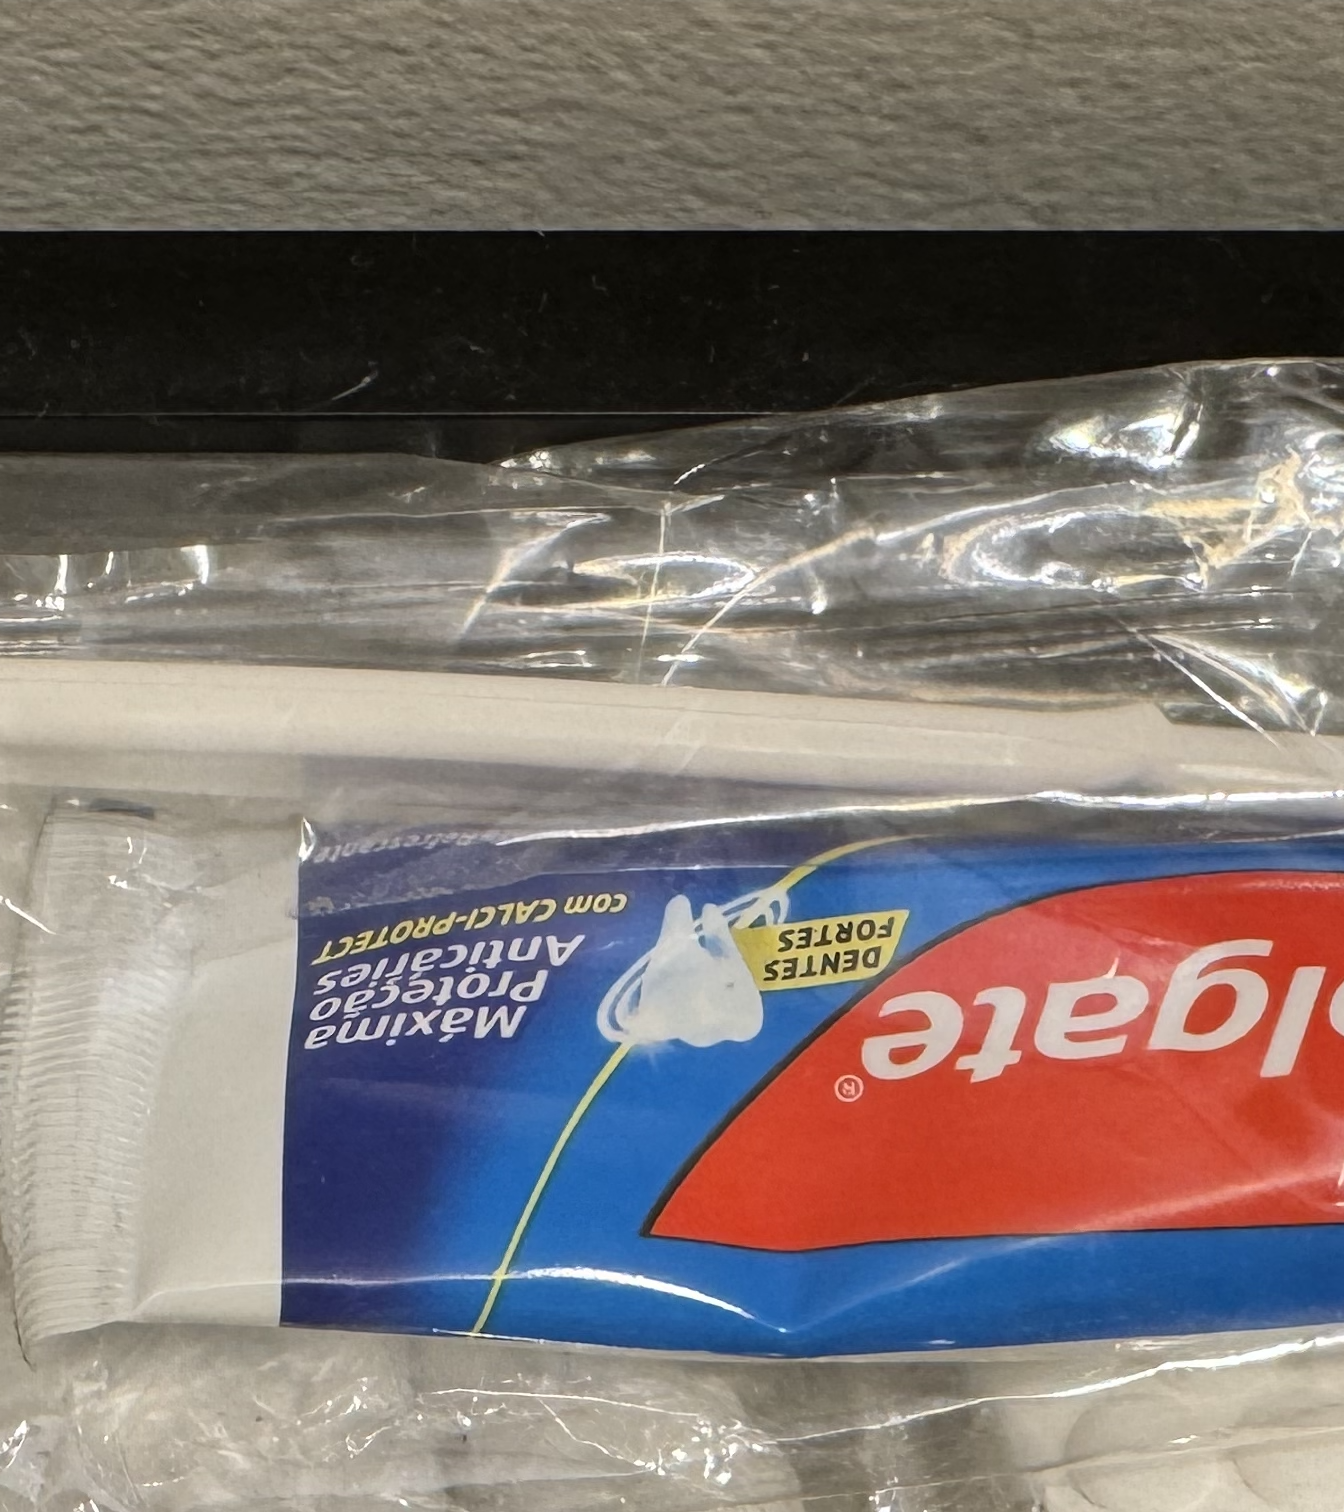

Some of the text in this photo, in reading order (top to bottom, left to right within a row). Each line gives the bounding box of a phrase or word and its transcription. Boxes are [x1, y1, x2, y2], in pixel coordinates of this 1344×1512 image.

[310, 893, 627, 965] com CALCI-PROTECT
[778, 917, 895, 952] FORTES
[313, 935, 585, 995] Anticáries
[763, 946, 881, 982] DENTES
[309, 969, 549, 1021] Proteção
[304, 1006, 527, 1050] Máxima
